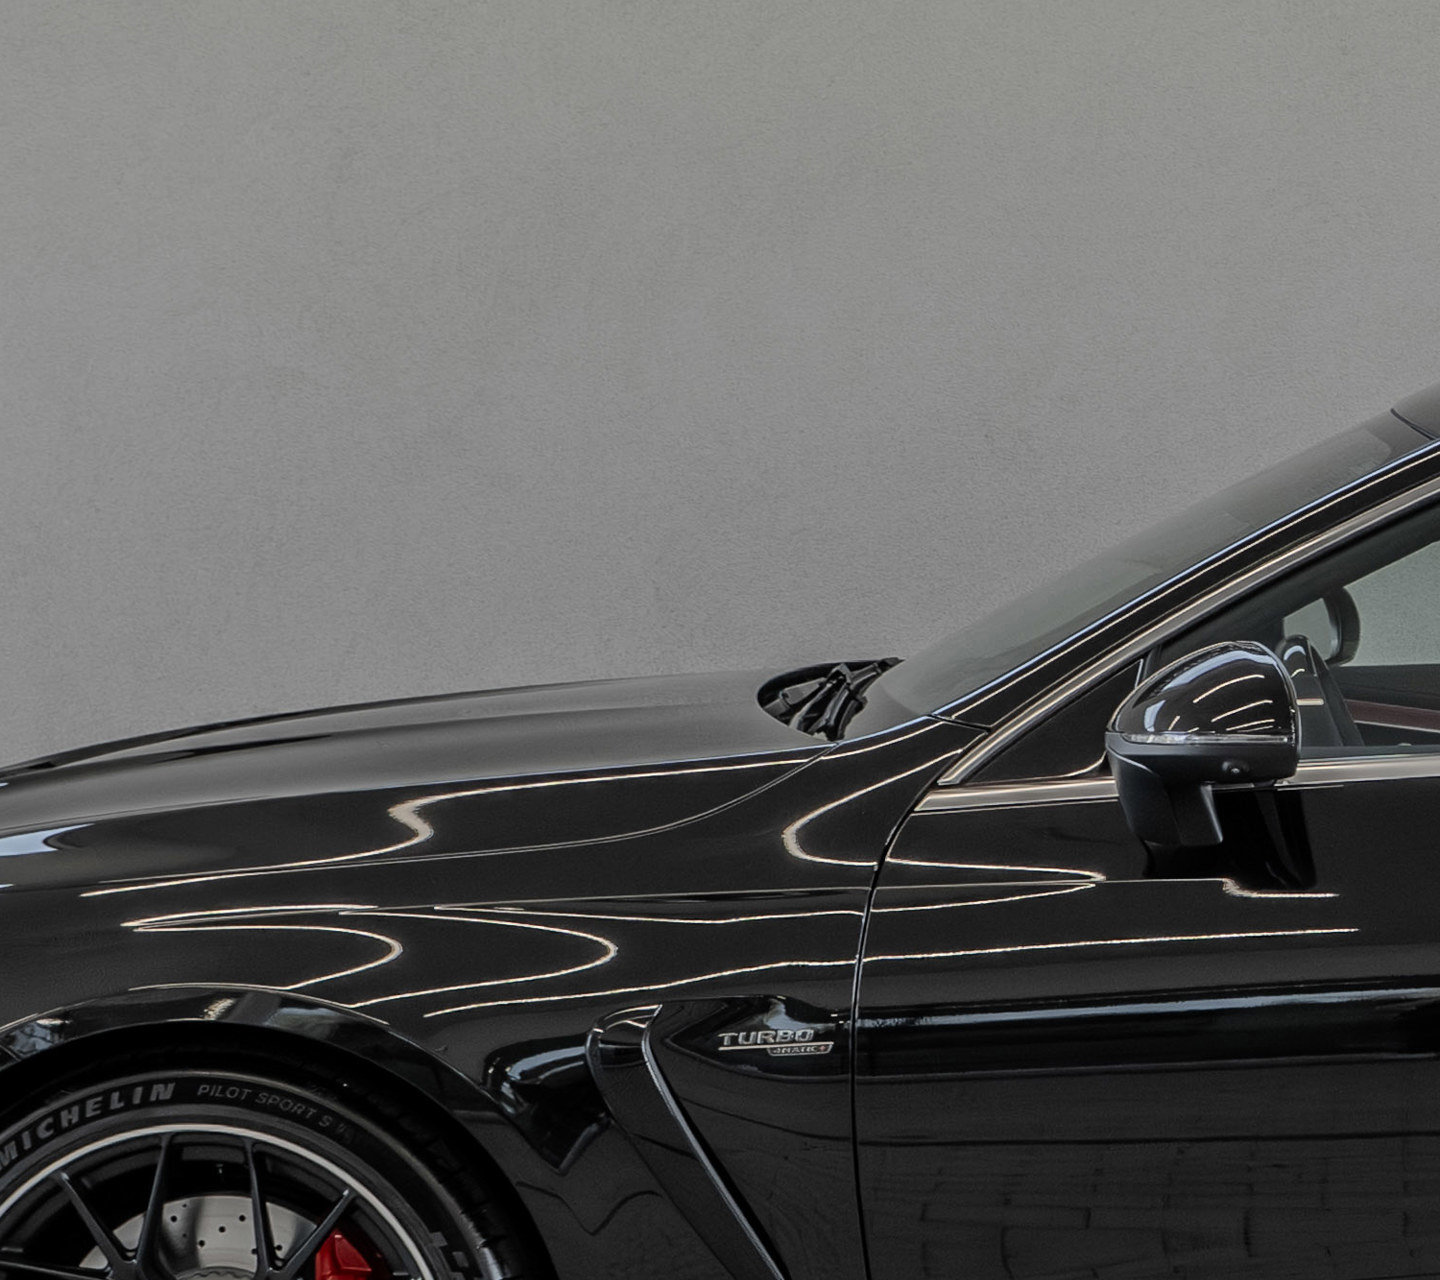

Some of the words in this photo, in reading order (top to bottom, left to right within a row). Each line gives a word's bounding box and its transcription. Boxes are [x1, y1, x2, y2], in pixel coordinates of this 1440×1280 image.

[718, 1029, 814, 1045] TURBO
[197, 1084, 252, 1101] PILOT
[255, 1093, 317, 1119] SPORT
